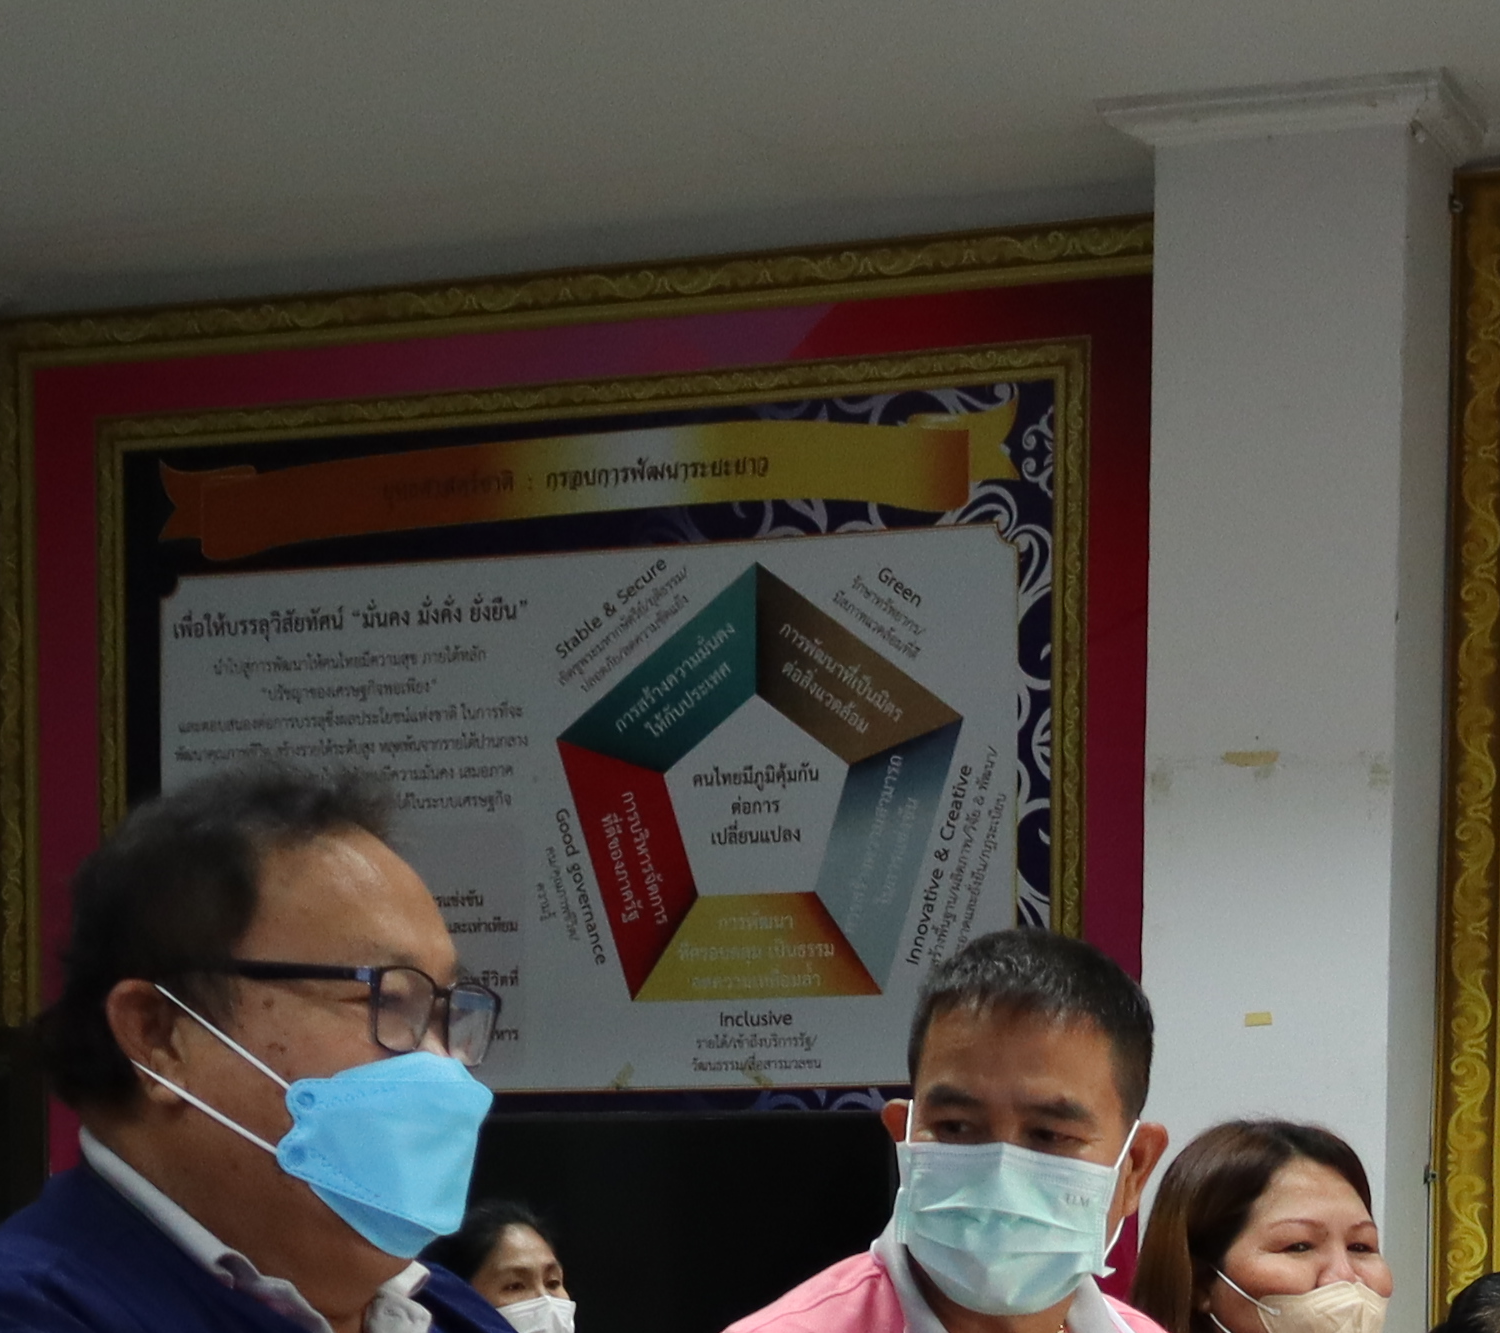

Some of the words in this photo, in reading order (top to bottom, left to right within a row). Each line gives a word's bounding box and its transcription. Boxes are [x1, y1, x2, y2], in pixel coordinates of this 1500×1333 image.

[172, 605, 345, 643] เพื่อให้บรรลุวิสัยทัศน์
[417, 594, 463, 627] มั่งคั่ง
[555, 614, 604, 661] Stable
[601, 601, 618, 618] &
[616, 557, 668, 605] Secure
[877, 566, 922, 609] Green
[614, 620, 737, 735] การสร้างความมั่นคง
[643, 660, 733, 738] ให้กับประเทศ
[778, 622, 905, 723] การพัฒนาที่เป็นมิตร
[781, 660, 870, 736] ต่อสิ่งแวดล้อม
[692, 761, 820, 792] คนไทยมีภูมิคุ้มกัน
[730, 794, 781, 815] ต่อการ
[939, 762, 973, 842] Creative
[555, 807, 581, 857] Good
[620, 791, 669, 925] การบริหารจัดการ
[710, 819, 802, 846] เปลี่ยนแปลง
[933, 845, 950, 863] &
[565, 862, 607, 966] governance
[905, 865, 944, 966] Innovative
[719, 1010, 793, 1028] Inclusive
